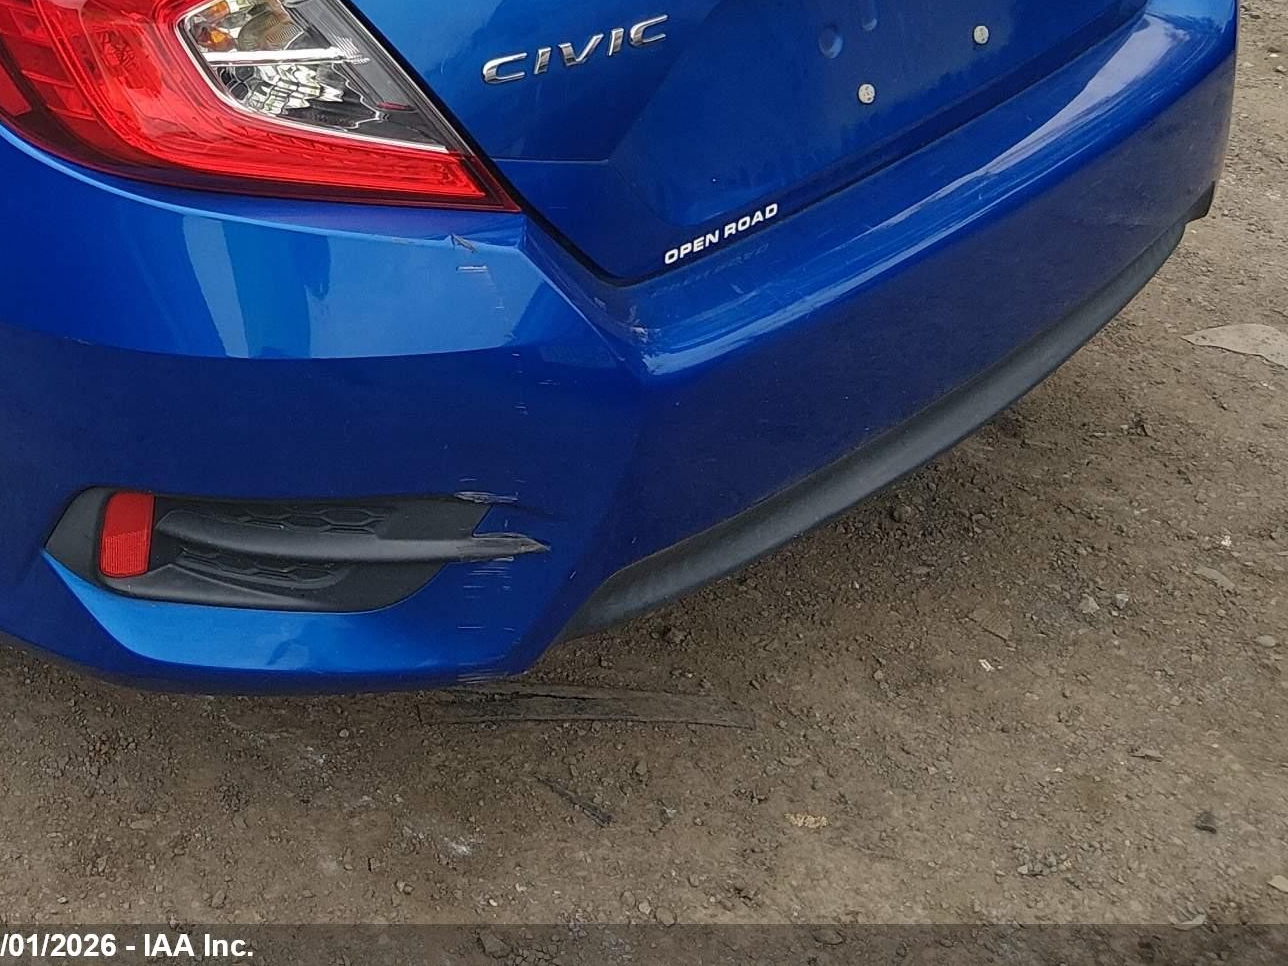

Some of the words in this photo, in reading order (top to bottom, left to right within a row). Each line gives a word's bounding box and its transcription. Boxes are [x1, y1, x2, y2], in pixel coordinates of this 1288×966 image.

[482, 14, 668, 84] CIVIC
[664, 229, 719, 265] OPEN
[723, 203, 778, 239] ROAD
